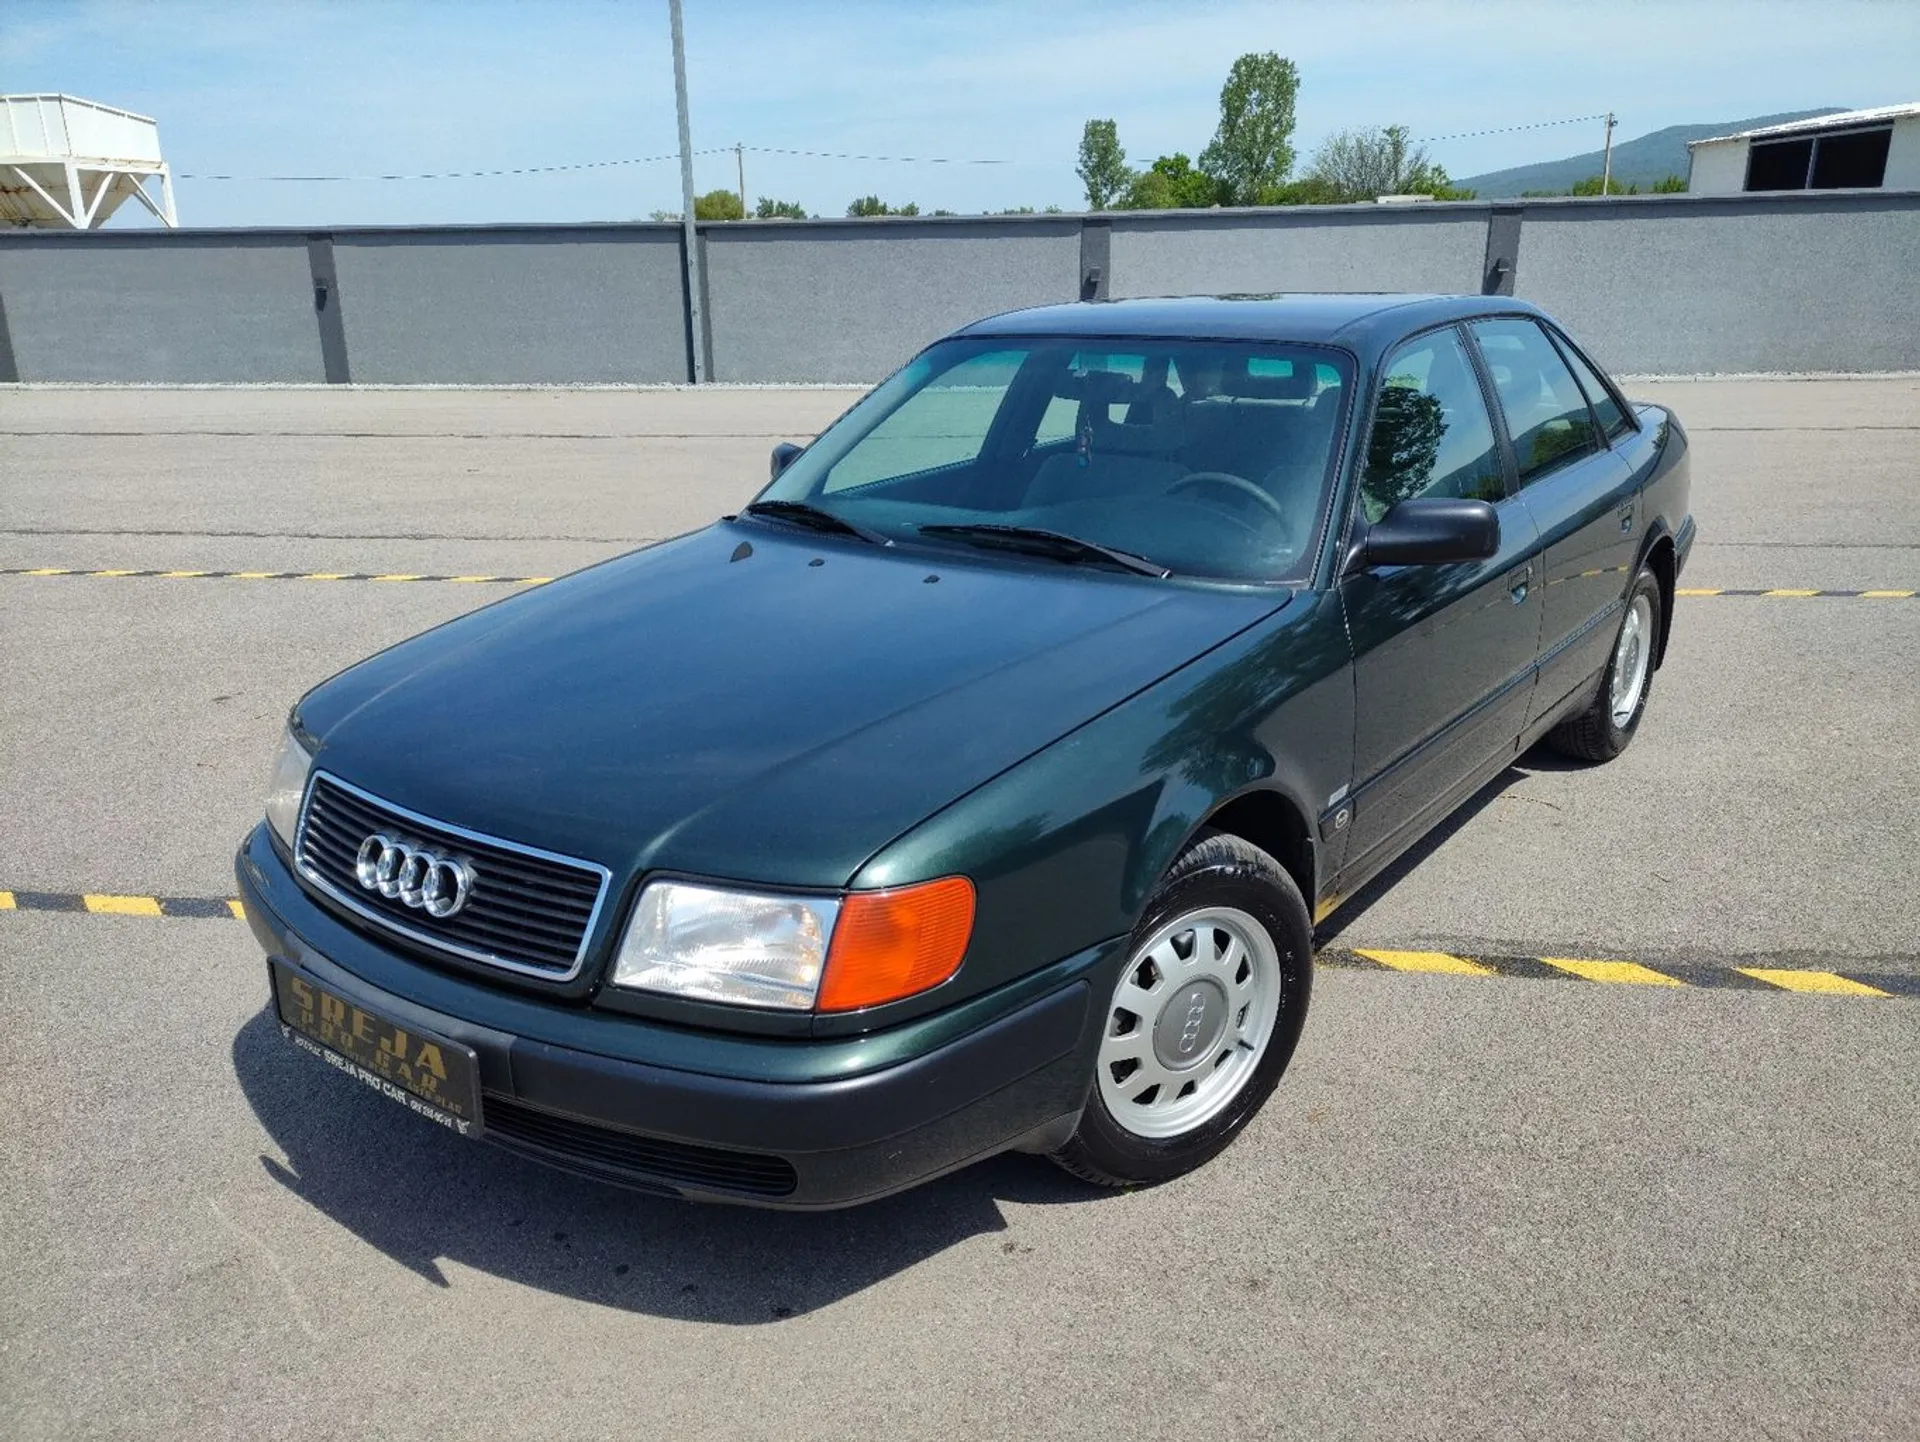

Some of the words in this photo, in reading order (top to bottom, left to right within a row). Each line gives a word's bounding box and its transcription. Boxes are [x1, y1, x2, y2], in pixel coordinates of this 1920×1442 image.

[291, 976, 447, 1080] SREJA
[301, 1008, 354, 1049] PRO
[375, 1049, 438, 1093] CAR
[323, 1049, 358, 1078] SREJA
[357, 1067, 381, 1091] PRO
[382, 1083, 407, 1106] CAR
